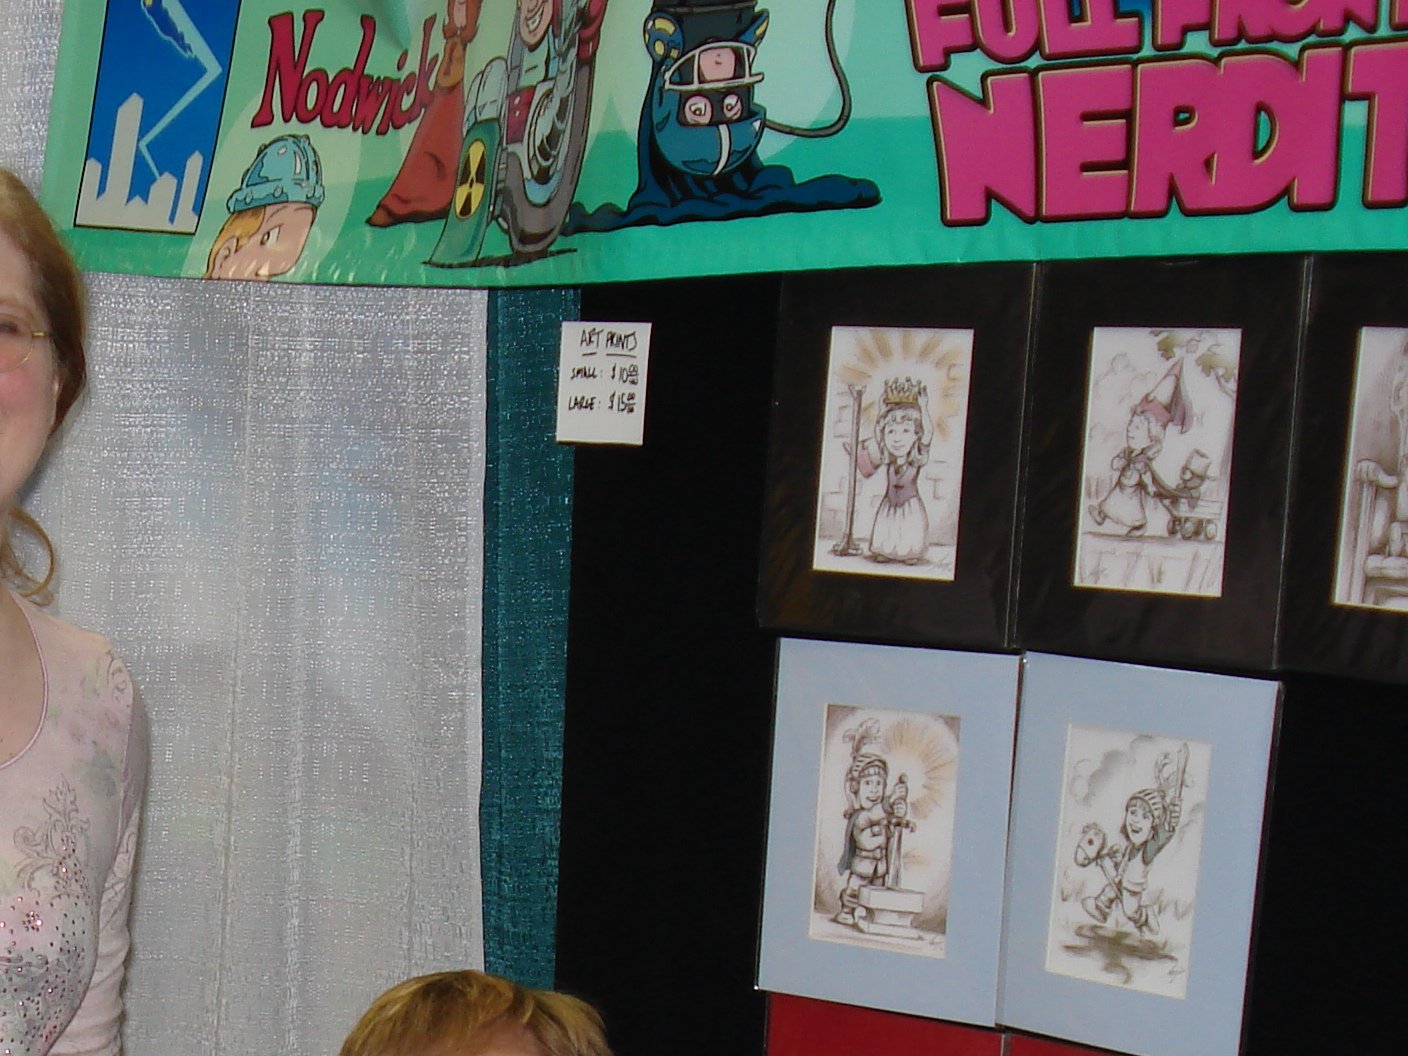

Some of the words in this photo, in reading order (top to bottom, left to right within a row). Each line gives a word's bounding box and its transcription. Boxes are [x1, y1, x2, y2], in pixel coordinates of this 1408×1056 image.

[251, 9, 439, 136] Nodwick
[579, 328, 604, 348] ART
[605, 330, 638, 352] PRINTS
